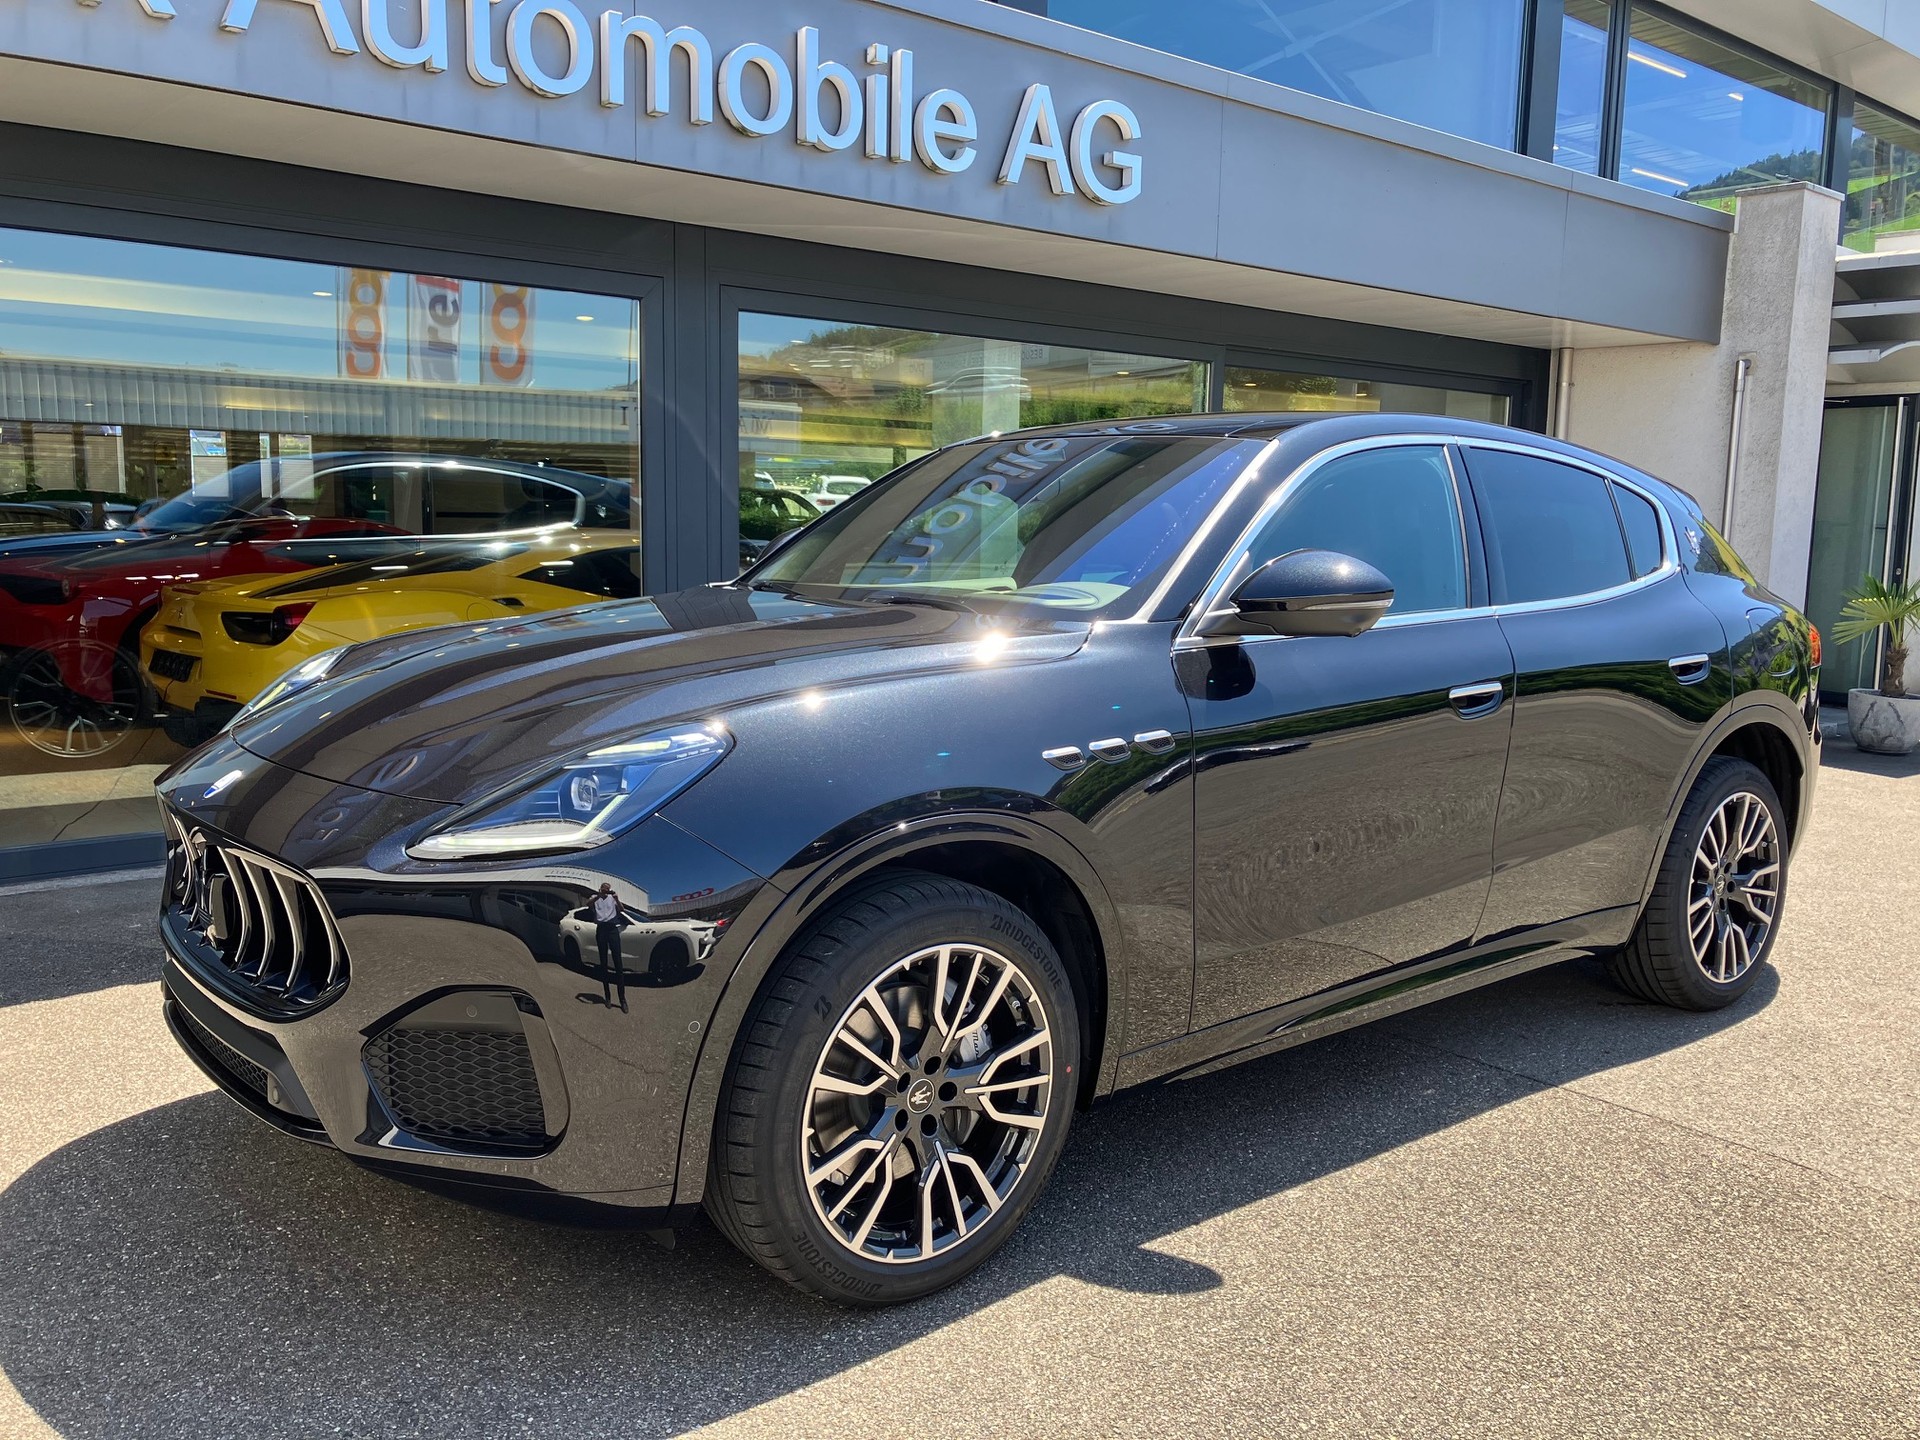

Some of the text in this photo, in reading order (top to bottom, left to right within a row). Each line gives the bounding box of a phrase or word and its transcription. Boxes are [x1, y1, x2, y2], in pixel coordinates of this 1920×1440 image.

[997, 83, 1142, 206] AG
[989, 914, 1063, 991] BRIDGESTONE
[791, 1230, 883, 1298] BRIDGESTONE
